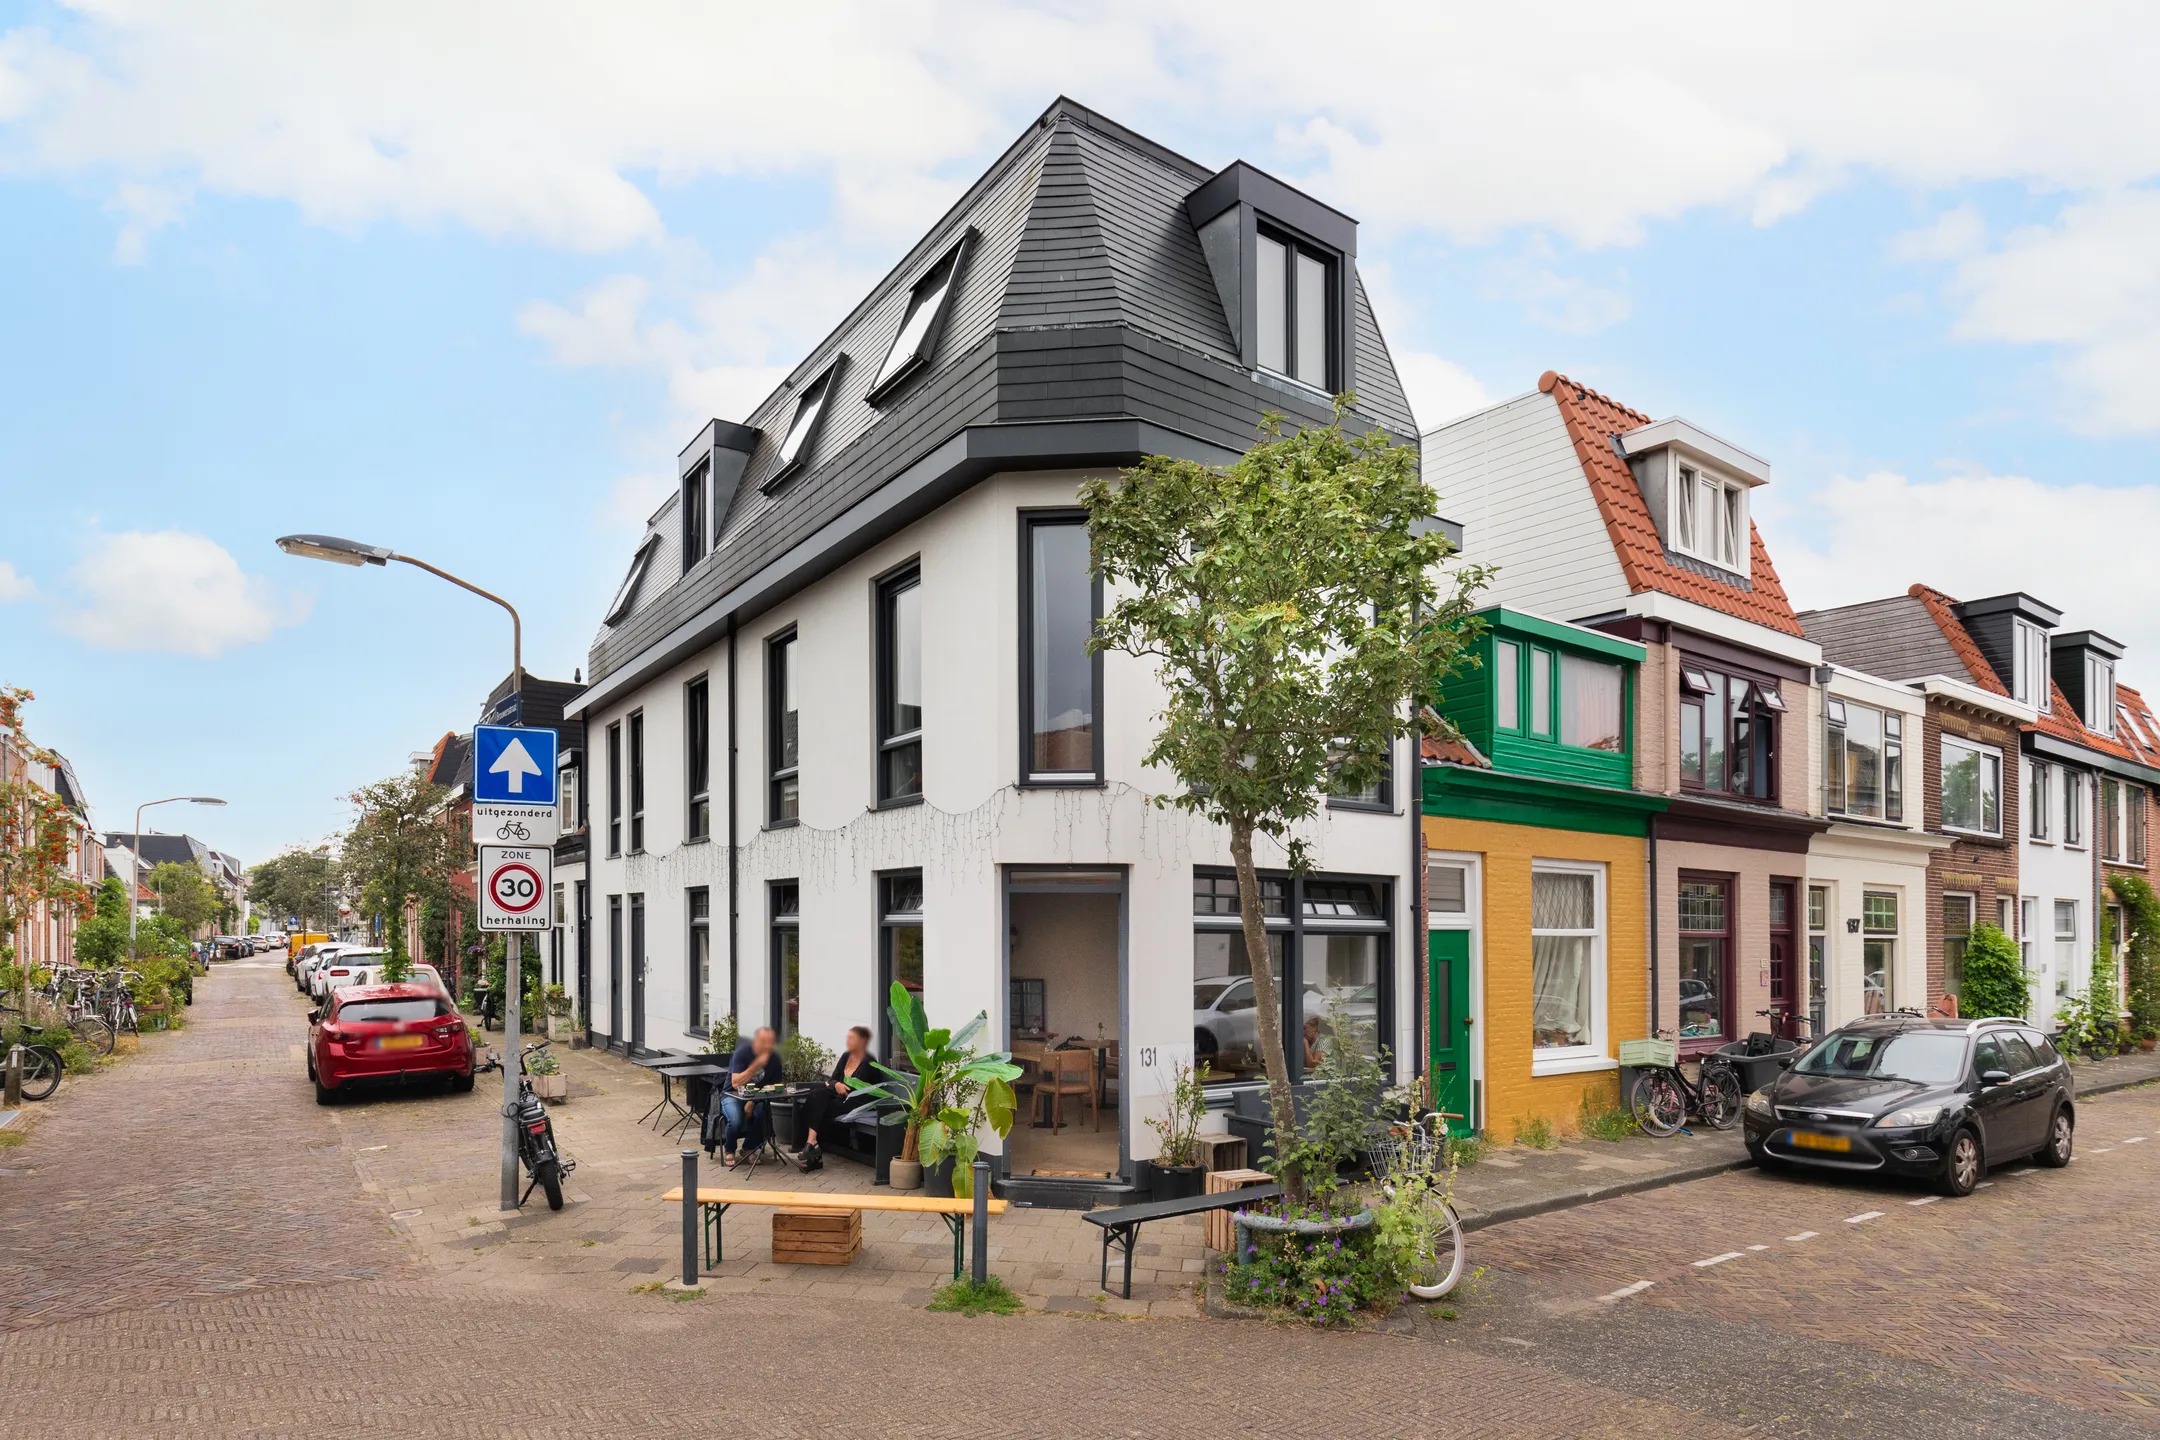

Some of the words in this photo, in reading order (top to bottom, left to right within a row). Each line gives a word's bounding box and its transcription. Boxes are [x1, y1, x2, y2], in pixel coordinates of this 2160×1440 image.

[477, 808, 552, 818] uitgezonderd
[501, 850, 531, 860] ZONE
[500, 878, 534, 898] 30
[486, 916, 546, 927] herhaling
[1140, 1046, 1157, 1067] 131
